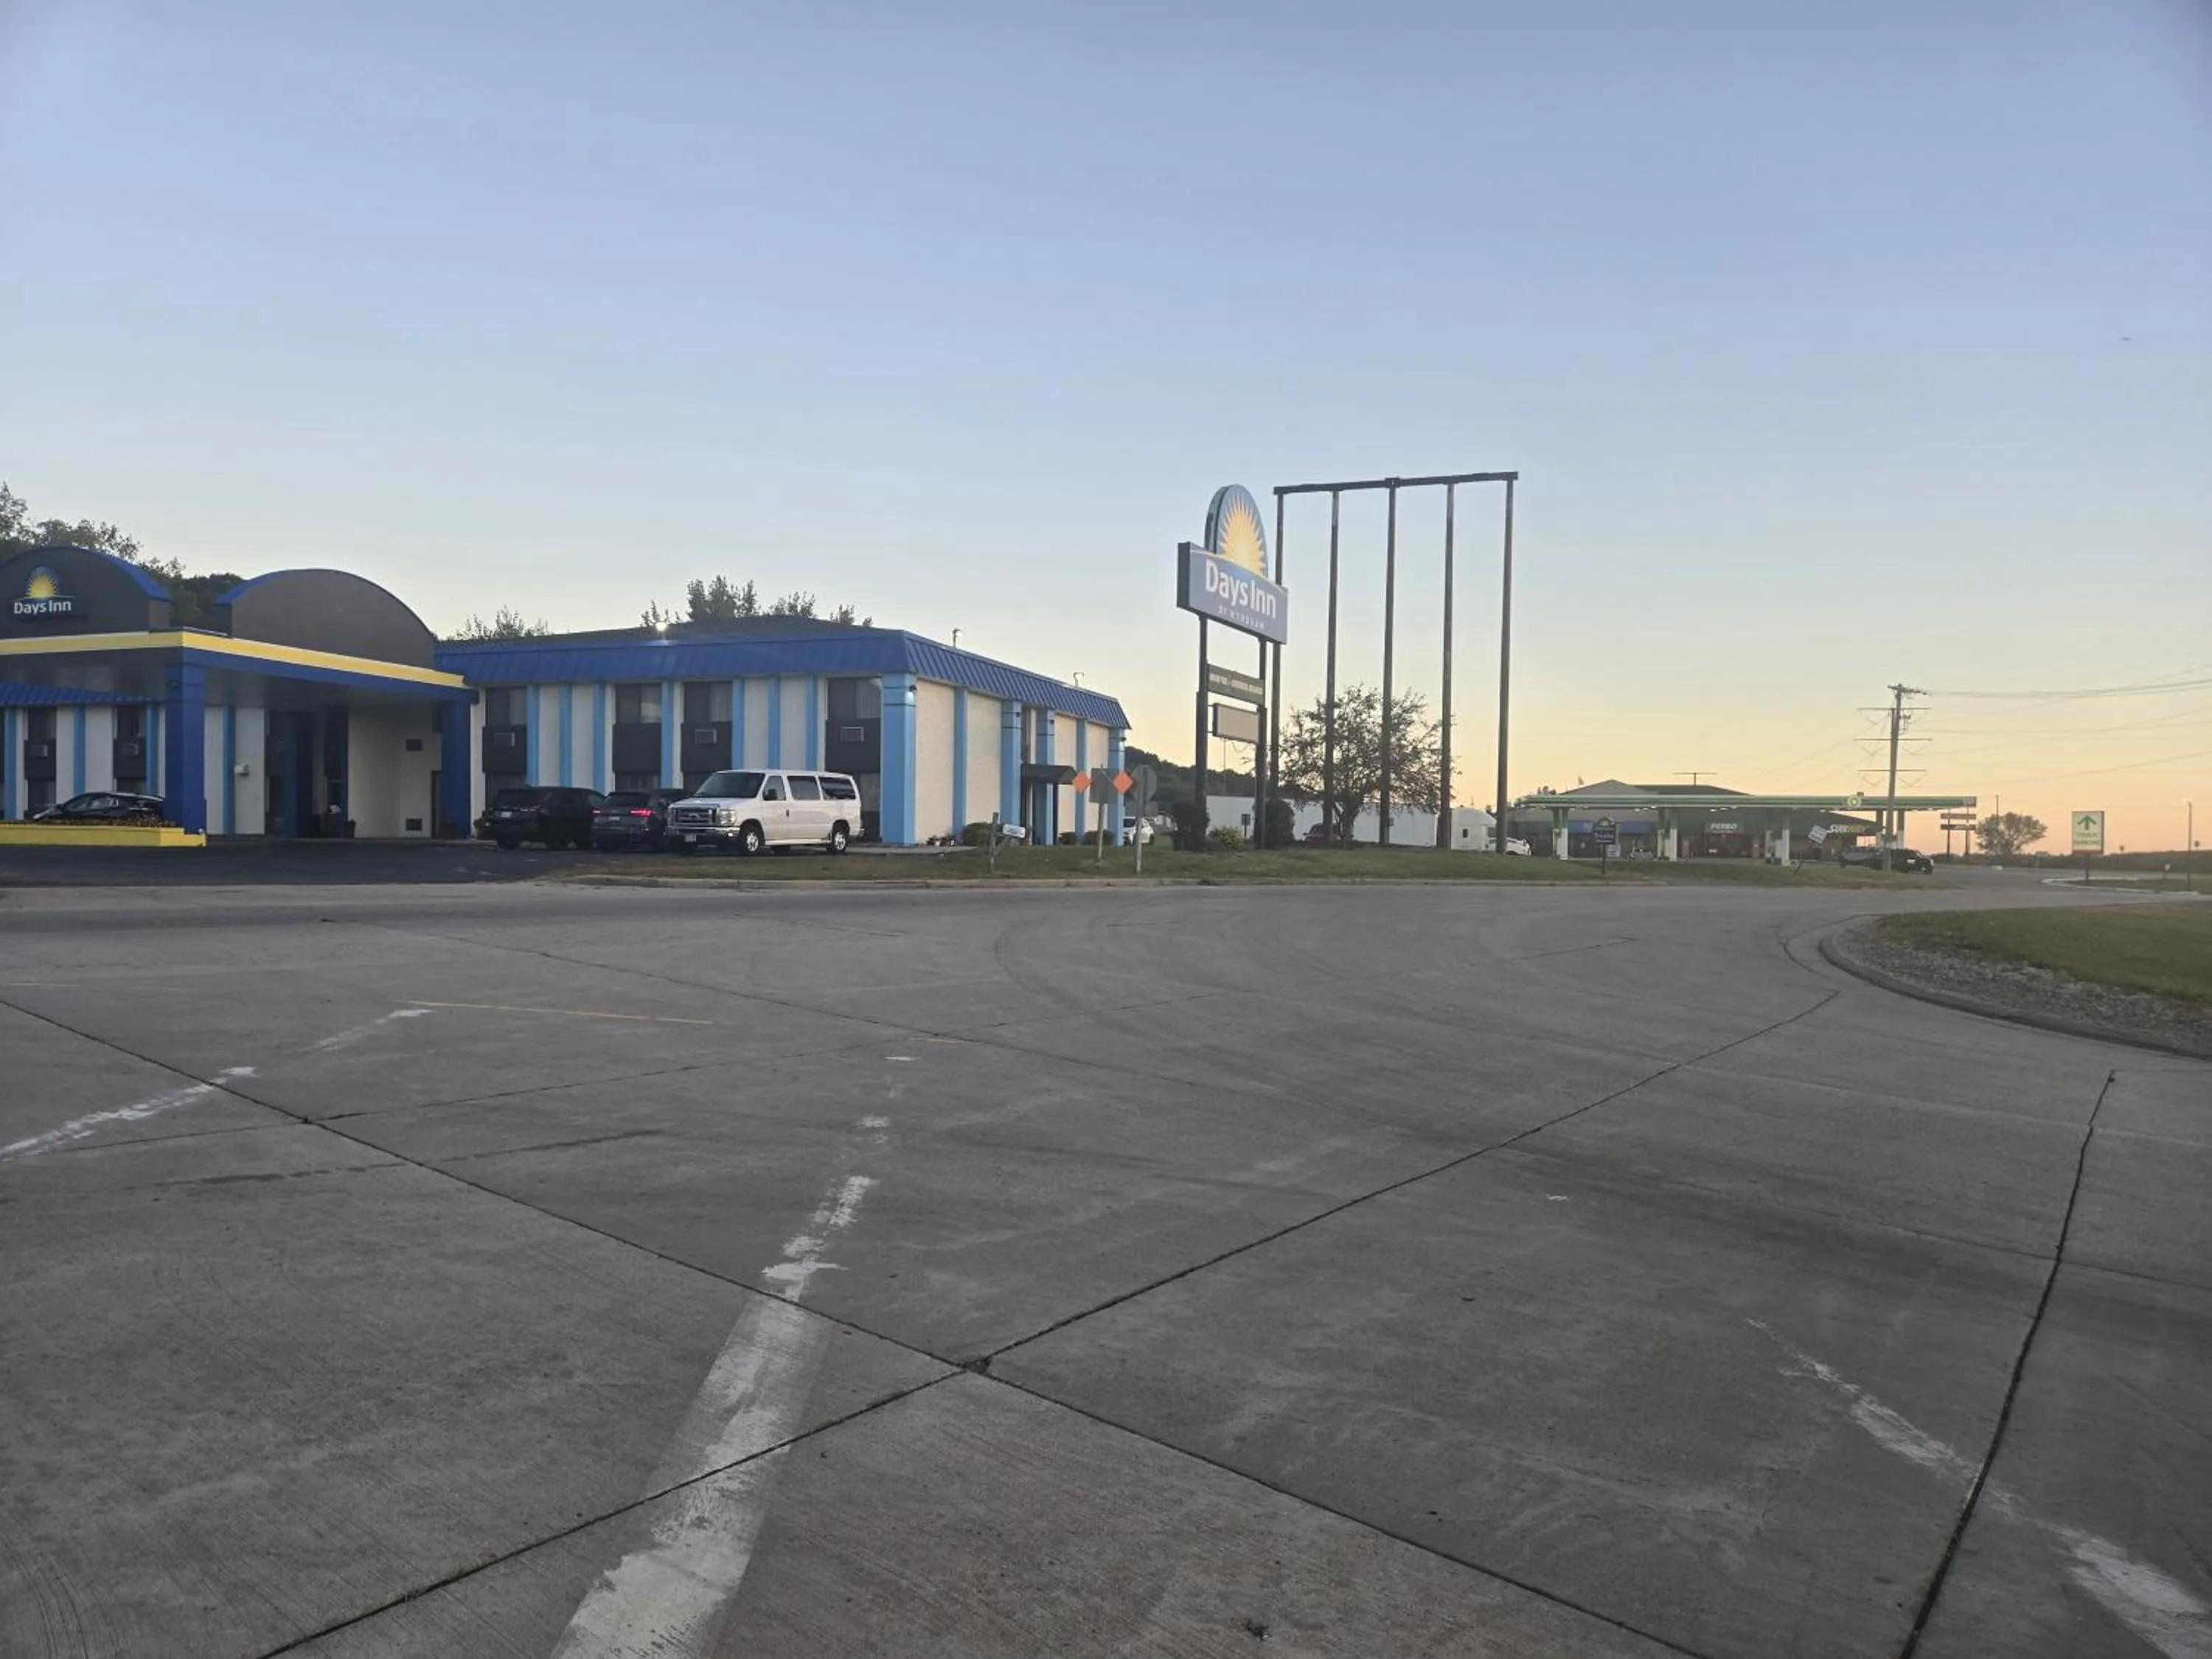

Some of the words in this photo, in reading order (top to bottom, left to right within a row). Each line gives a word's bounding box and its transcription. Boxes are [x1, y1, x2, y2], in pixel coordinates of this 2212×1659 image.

[14, 601, 46, 615] Days
[48, 599, 72, 613] Inn
[1206, 559, 1248, 607] Days
[1250, 578, 1276, 619] Inn
